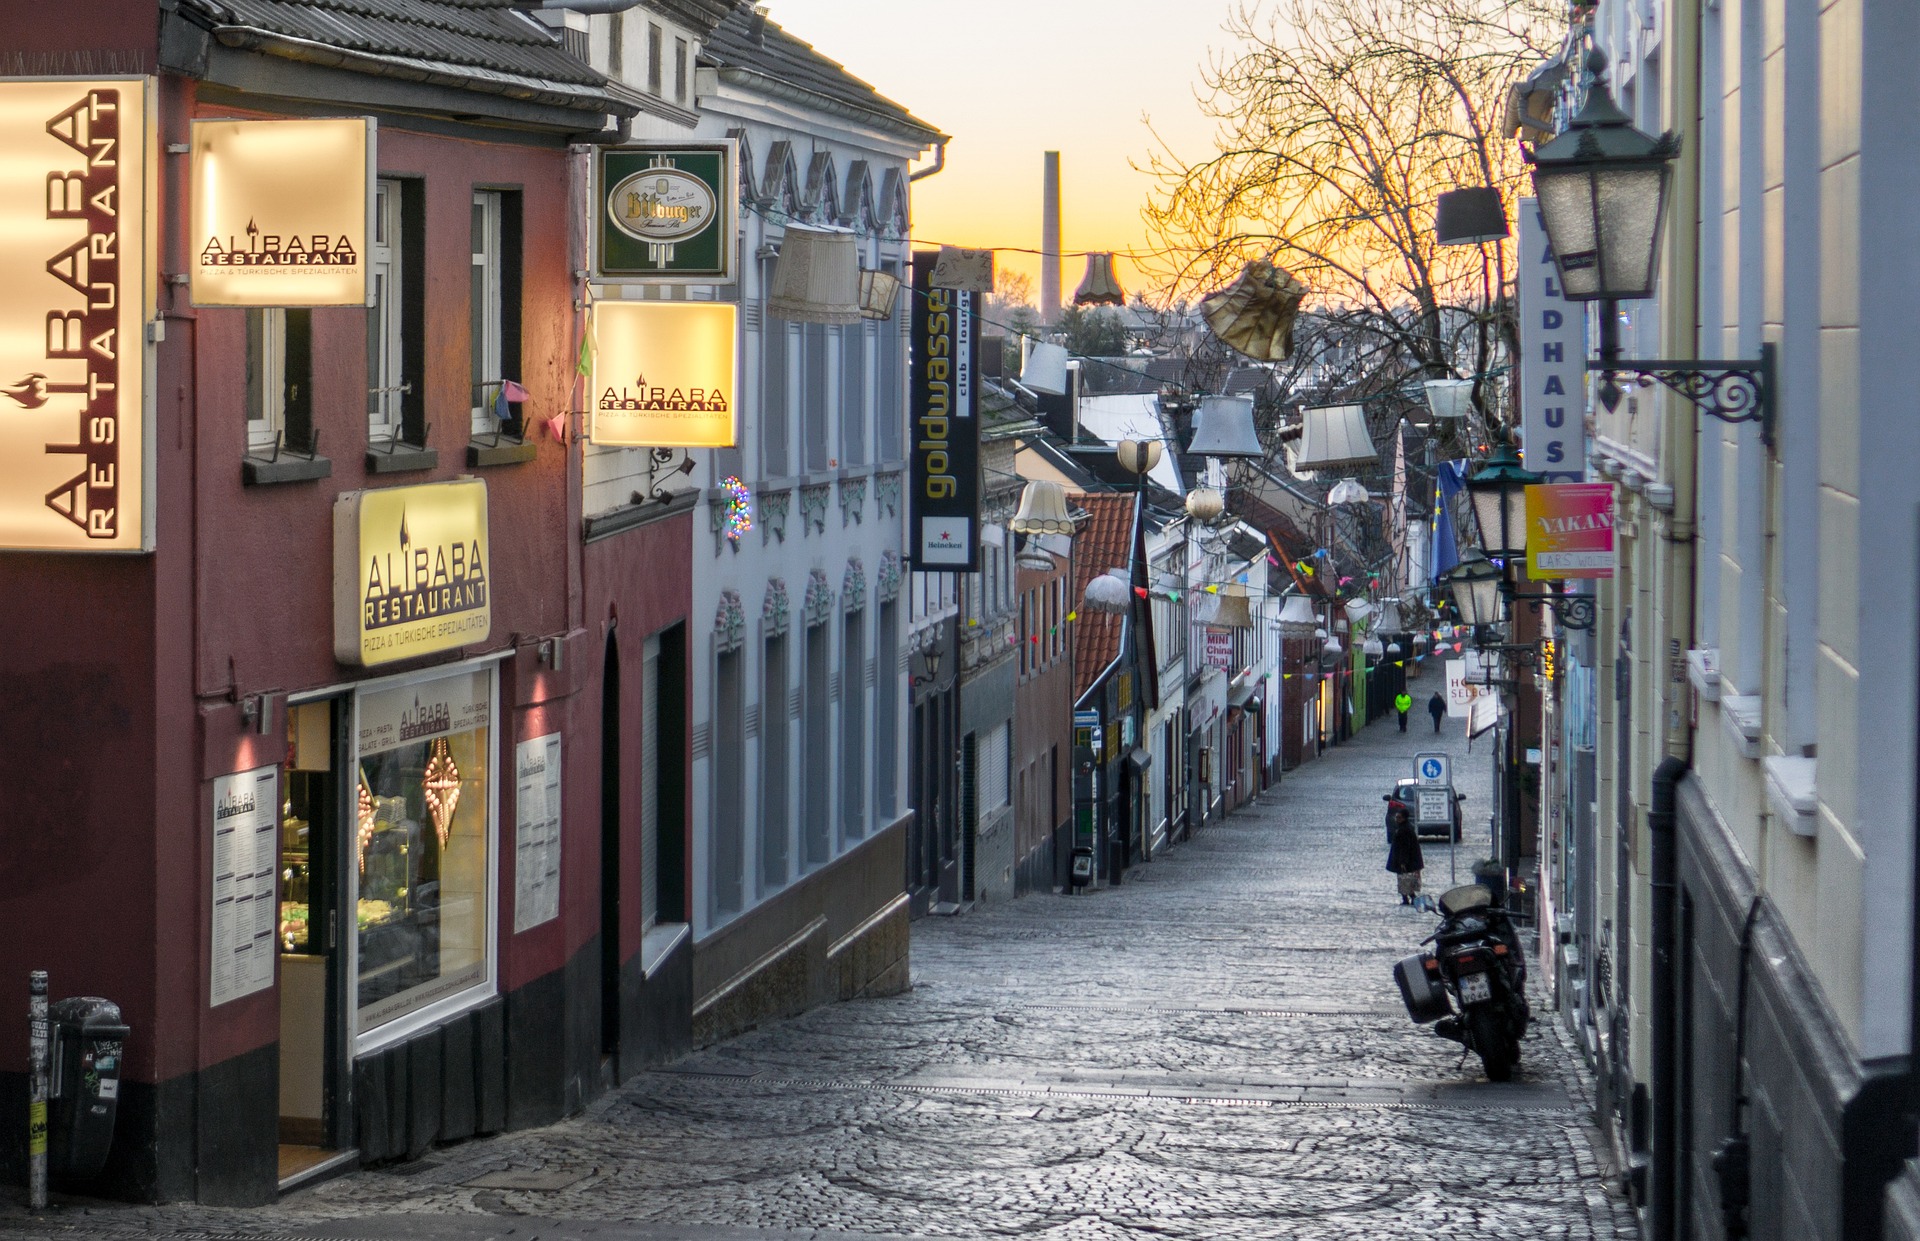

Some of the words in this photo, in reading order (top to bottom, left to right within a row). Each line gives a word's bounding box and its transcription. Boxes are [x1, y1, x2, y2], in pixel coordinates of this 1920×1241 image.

[625, 192, 702, 223] Bitburger
[204, 235, 354, 253] ALIBABA
[202, 253, 356, 265] RESTAURANT
[237, 267, 288, 275] TÜRKISCHE
[291, 267, 358, 275] SPEZIALITÄTEN
[45, 93, 89, 533] ALIBABA
[89, 93, 116, 537] RESTAURANT
[958, 362, 967, 397] club
[601, 387, 725, 402] ALIBABA
[600, 401, 727, 410] RESTAURANT
[928, 541, 962, 549] Heineken
[366, 539, 485, 598] ALIBABA
[1539, 553, 1573, 568] LARS
[365, 581, 486, 625] RESTAURANT
[364, 636, 386, 651] PIZZA
[387, 634, 393, 648] &
[394, 625, 436, 645] TÜRKISCHE
[438, 613, 488, 637] SPEZIALITÄTEN
[1207, 635, 1229, 644] MINI
[1207, 645, 1232, 655] China
[1207, 655, 1228, 665] Thai
[401, 702, 450, 728] ALIBABA
[400, 719, 450, 740] RESTAURANT
